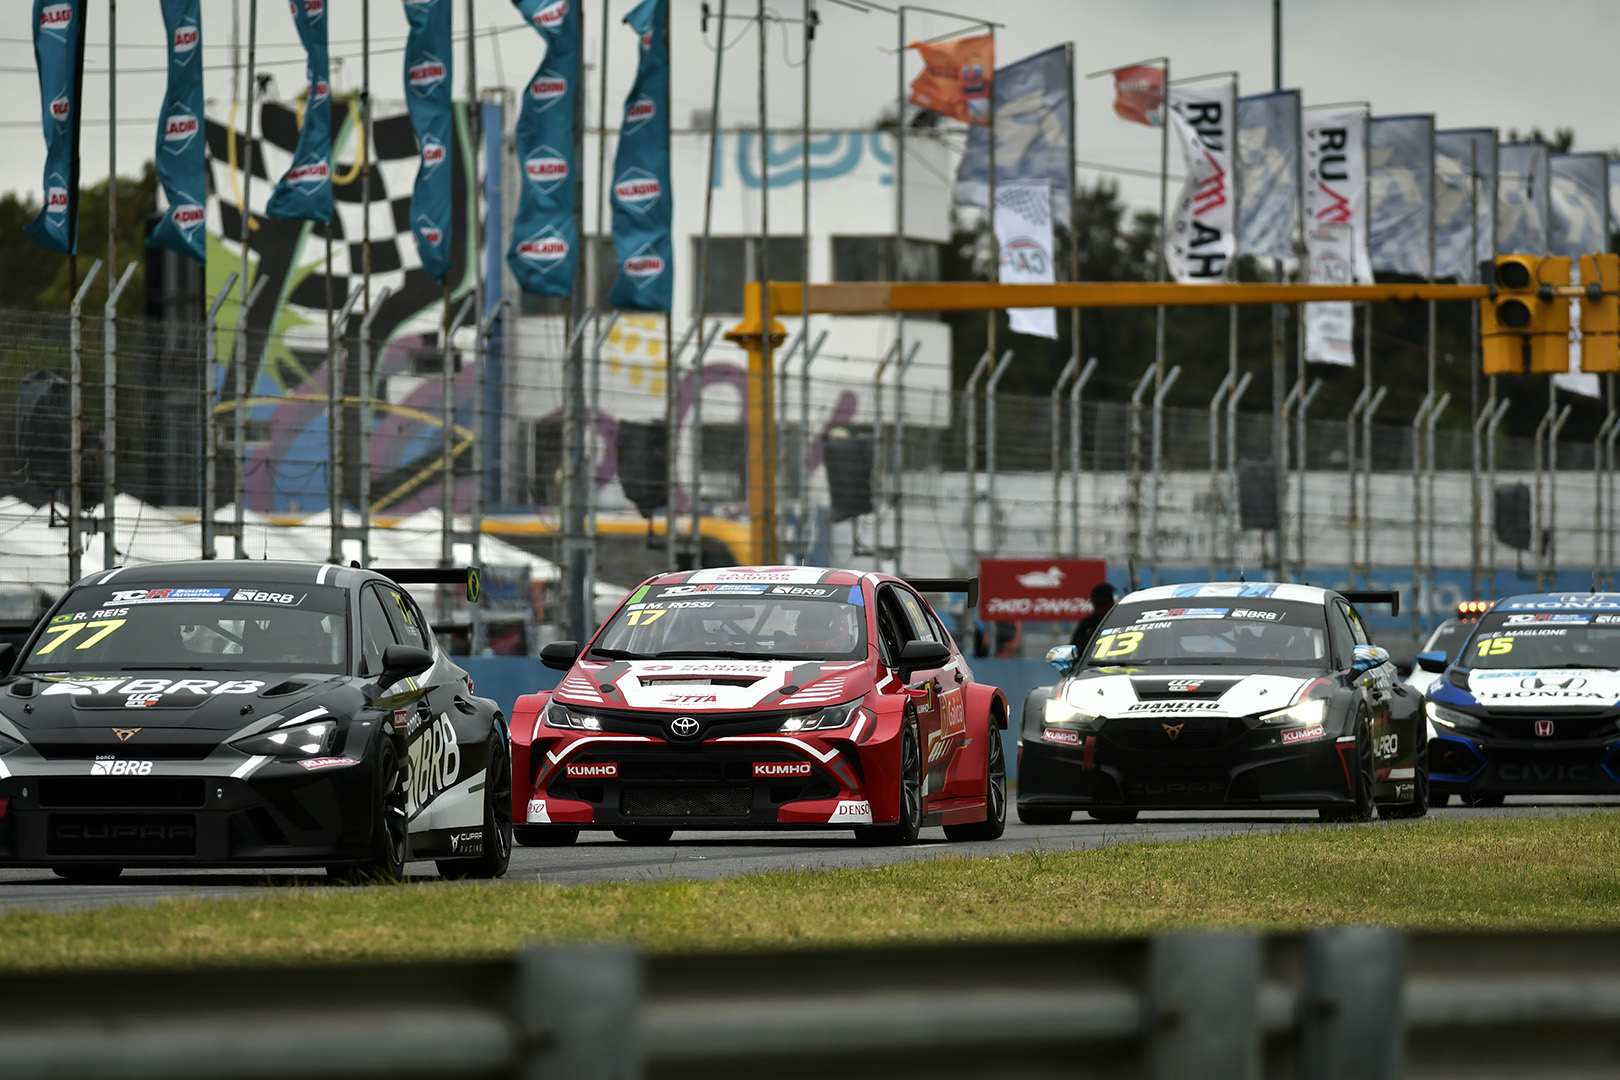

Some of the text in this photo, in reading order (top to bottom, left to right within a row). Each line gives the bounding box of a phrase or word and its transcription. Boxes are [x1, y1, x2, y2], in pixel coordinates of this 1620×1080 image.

[1316, 127, 1352, 225] RUM
[111, 589, 174, 601] TCR
[663, 585, 719, 595] TCR
[789, 587, 827, 596] BRB
[253, 592, 295, 603] BRB
[668, 601, 715, 609] ROSSI
[73, 608, 129, 620] R. REIS
[626, 609, 667, 626] 17
[1141, 608, 1187, 619] TCR
[1246, 610, 1278, 620] BRB
[1507, 613, 1552, 623] TCR
[1111, 622, 1172, 635] F. PEZZINI
[1504, 629, 1568, 638] MAGLIONE
[36, 619, 127, 655] 77
[1094, 631, 1145, 659] 13
[1477, 637, 1515, 657] 15
[118, 679, 266, 694] BRB
[1491, 691, 1605, 699] HONDA
[1128, 702, 1220, 711] GIANELLO
[1046, 731, 1078, 742] KUMHO
[1283, 728, 1322, 741] KUMHO
[419, 712, 460, 804] BRB
[112, 761, 153, 775] BRB
[567, 766, 617, 776] KUMHO
[754, 764, 811, 775] KUMHO
[1498, 764, 1590, 781] CIVIC
[839, 803, 870, 815] DENSO
[56, 823, 194, 840] CUPRA
[461, 833, 482, 841] CUPRA
